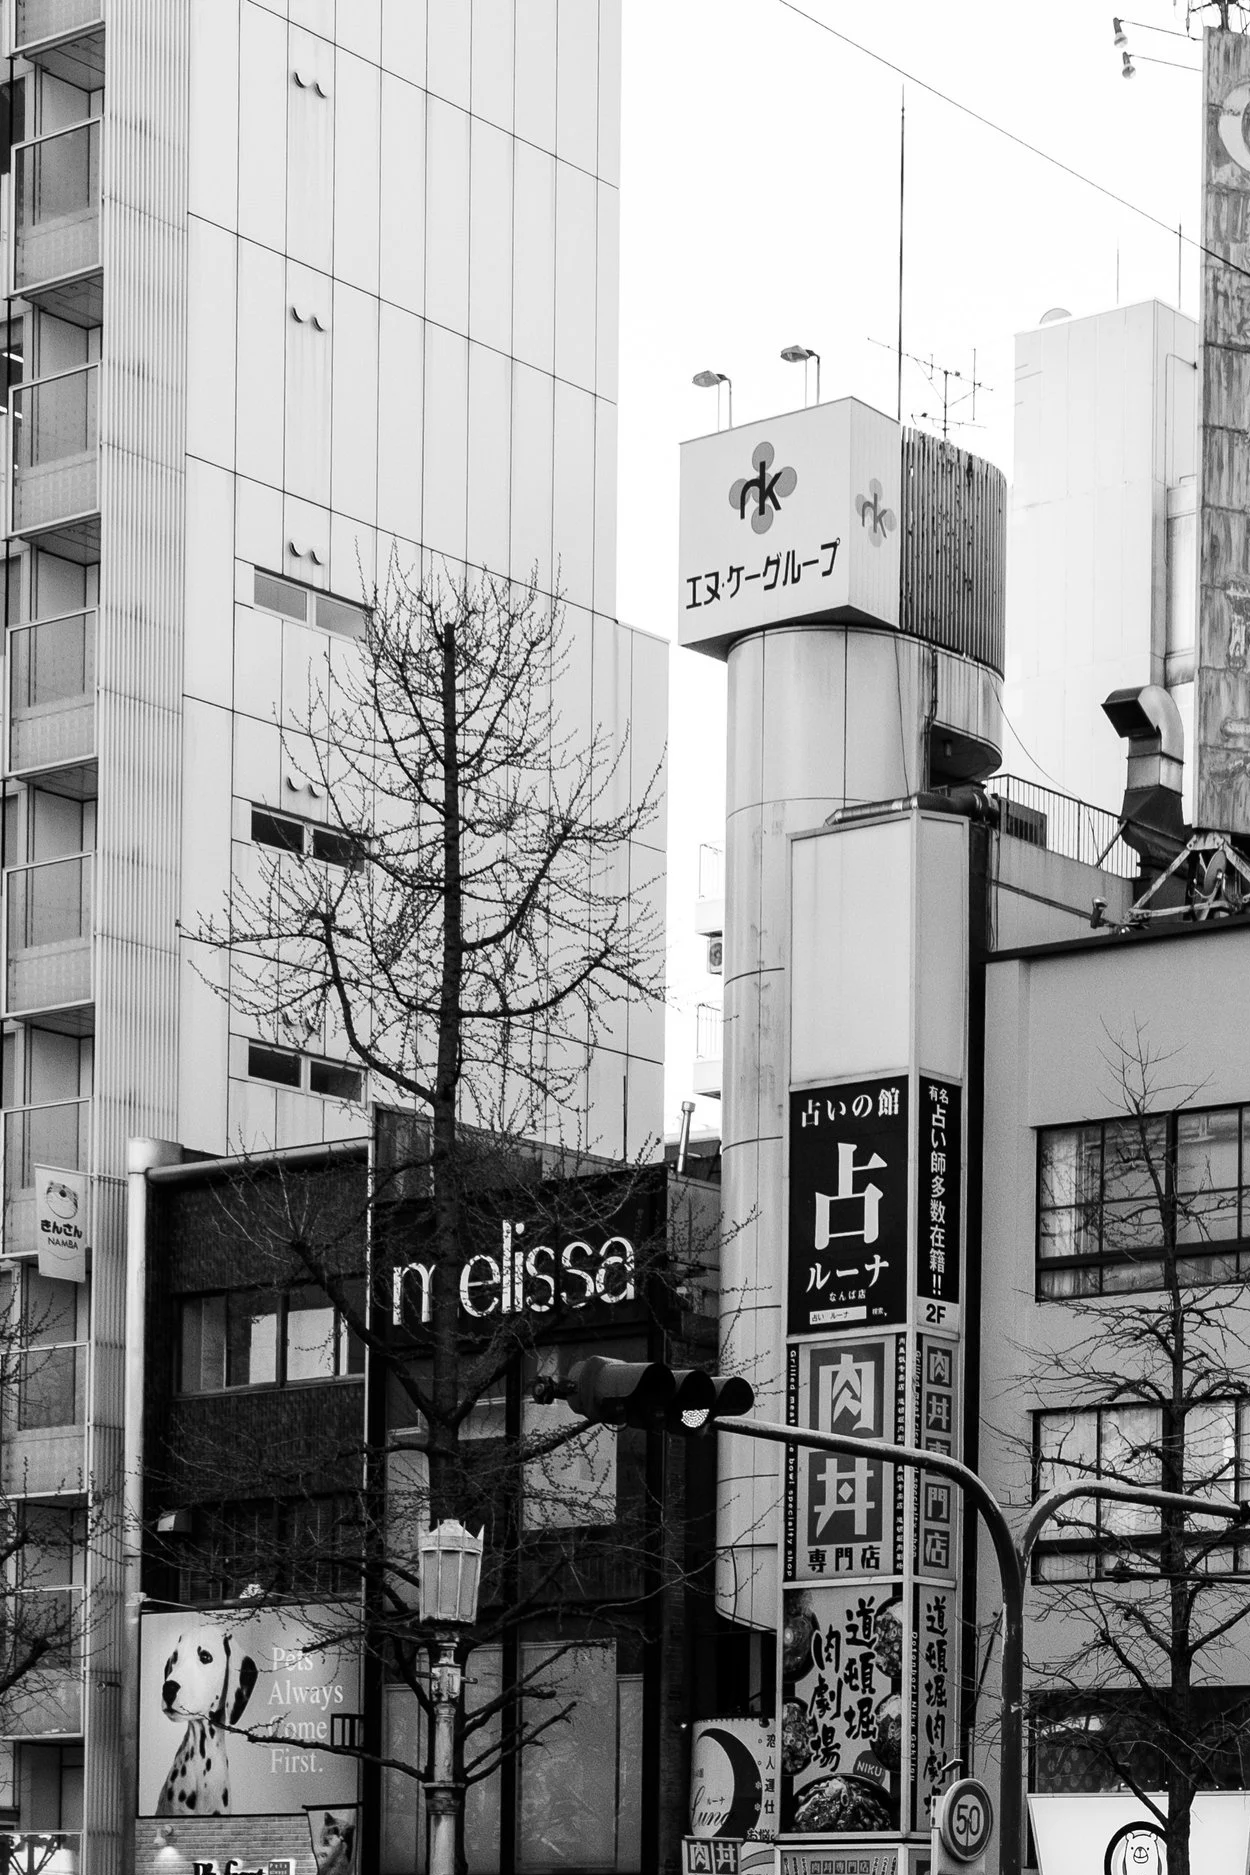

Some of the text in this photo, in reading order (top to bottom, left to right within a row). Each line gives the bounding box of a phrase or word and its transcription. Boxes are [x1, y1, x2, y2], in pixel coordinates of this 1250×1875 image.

[801, 1087, 900, 1128] 占いの館
[814, 1142, 888, 1251] 占
[41, 1218, 83, 1241] きんさん
[47, 1237, 79, 1251] NAMBA
[805, 1254, 890, 1293] ルーナ
[829, 1289, 867, 1302] なんば店
[926, 1303, 947, 1325] 2F
[789, 1349, 797, 1390] Grilled
[814, 1353, 876, 1539] 肉丼
[787, 1489, 795, 1545] specialty
[786, 1550, 794, 1577] shop
[808, 1545, 881, 1573] 専門店
[271, 1645, 315, 1672] Pets
[844, 1595, 878, 1742] 道頓堀
[267, 1679, 344, 1712] Always
[809, 1623, 843, 1773] 肉劇場
[267, 1714, 328, 1740] Come
[270, 1749, 325, 1776] First.
[856, 1760, 883, 1778] NIKU
[955, 1804, 981, 1836] 50
[688, 1841, 737, 1873] 肉丼
